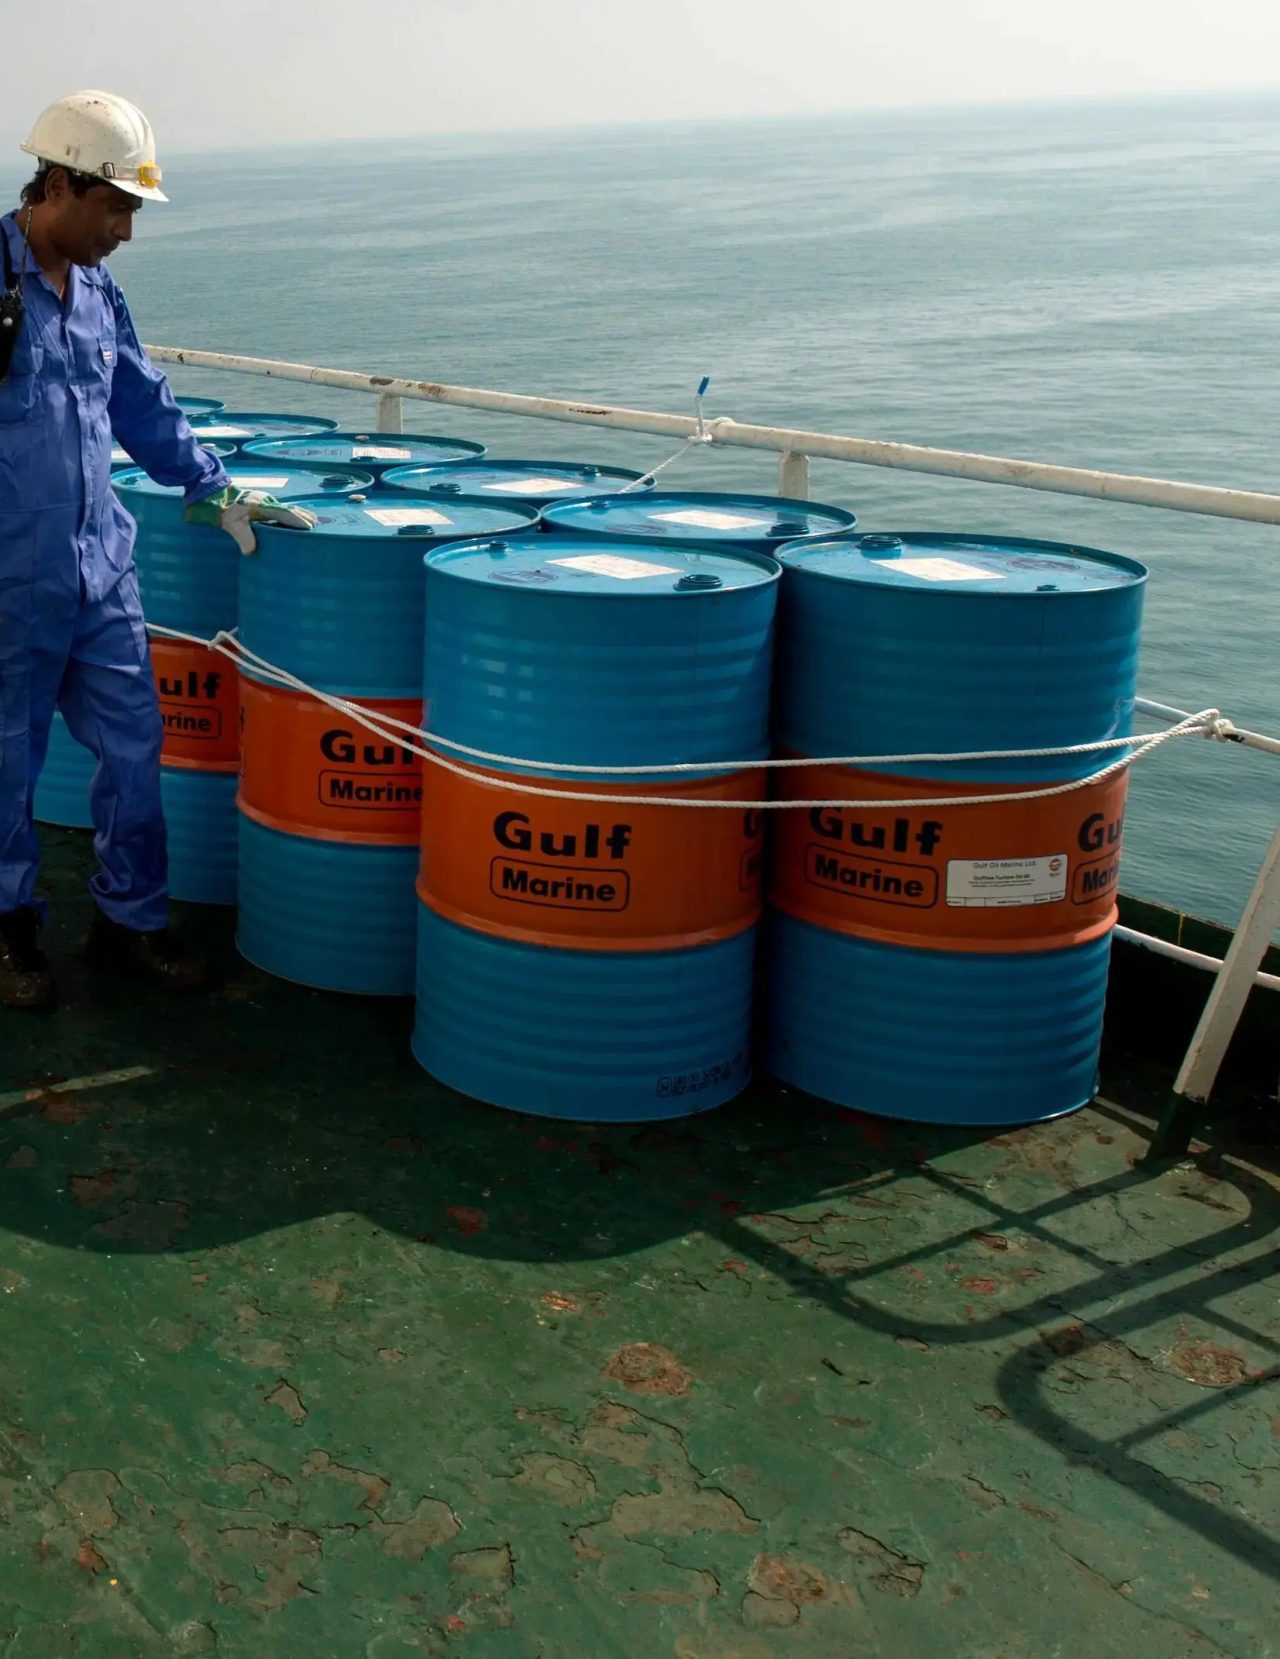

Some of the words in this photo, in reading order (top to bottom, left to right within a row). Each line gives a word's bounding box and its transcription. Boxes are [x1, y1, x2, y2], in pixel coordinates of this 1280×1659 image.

[159, 671, 222, 699] ulf
[161, 711, 211, 731] rine
[320, 728, 415, 766] Gul
[493, 810, 632, 860] Gulf
[809, 806, 943, 856] Gulf
[1078, 812, 1123, 852] Gu
[502, 866, 616, 902] Marine
[815, 853, 924, 898] Marine
